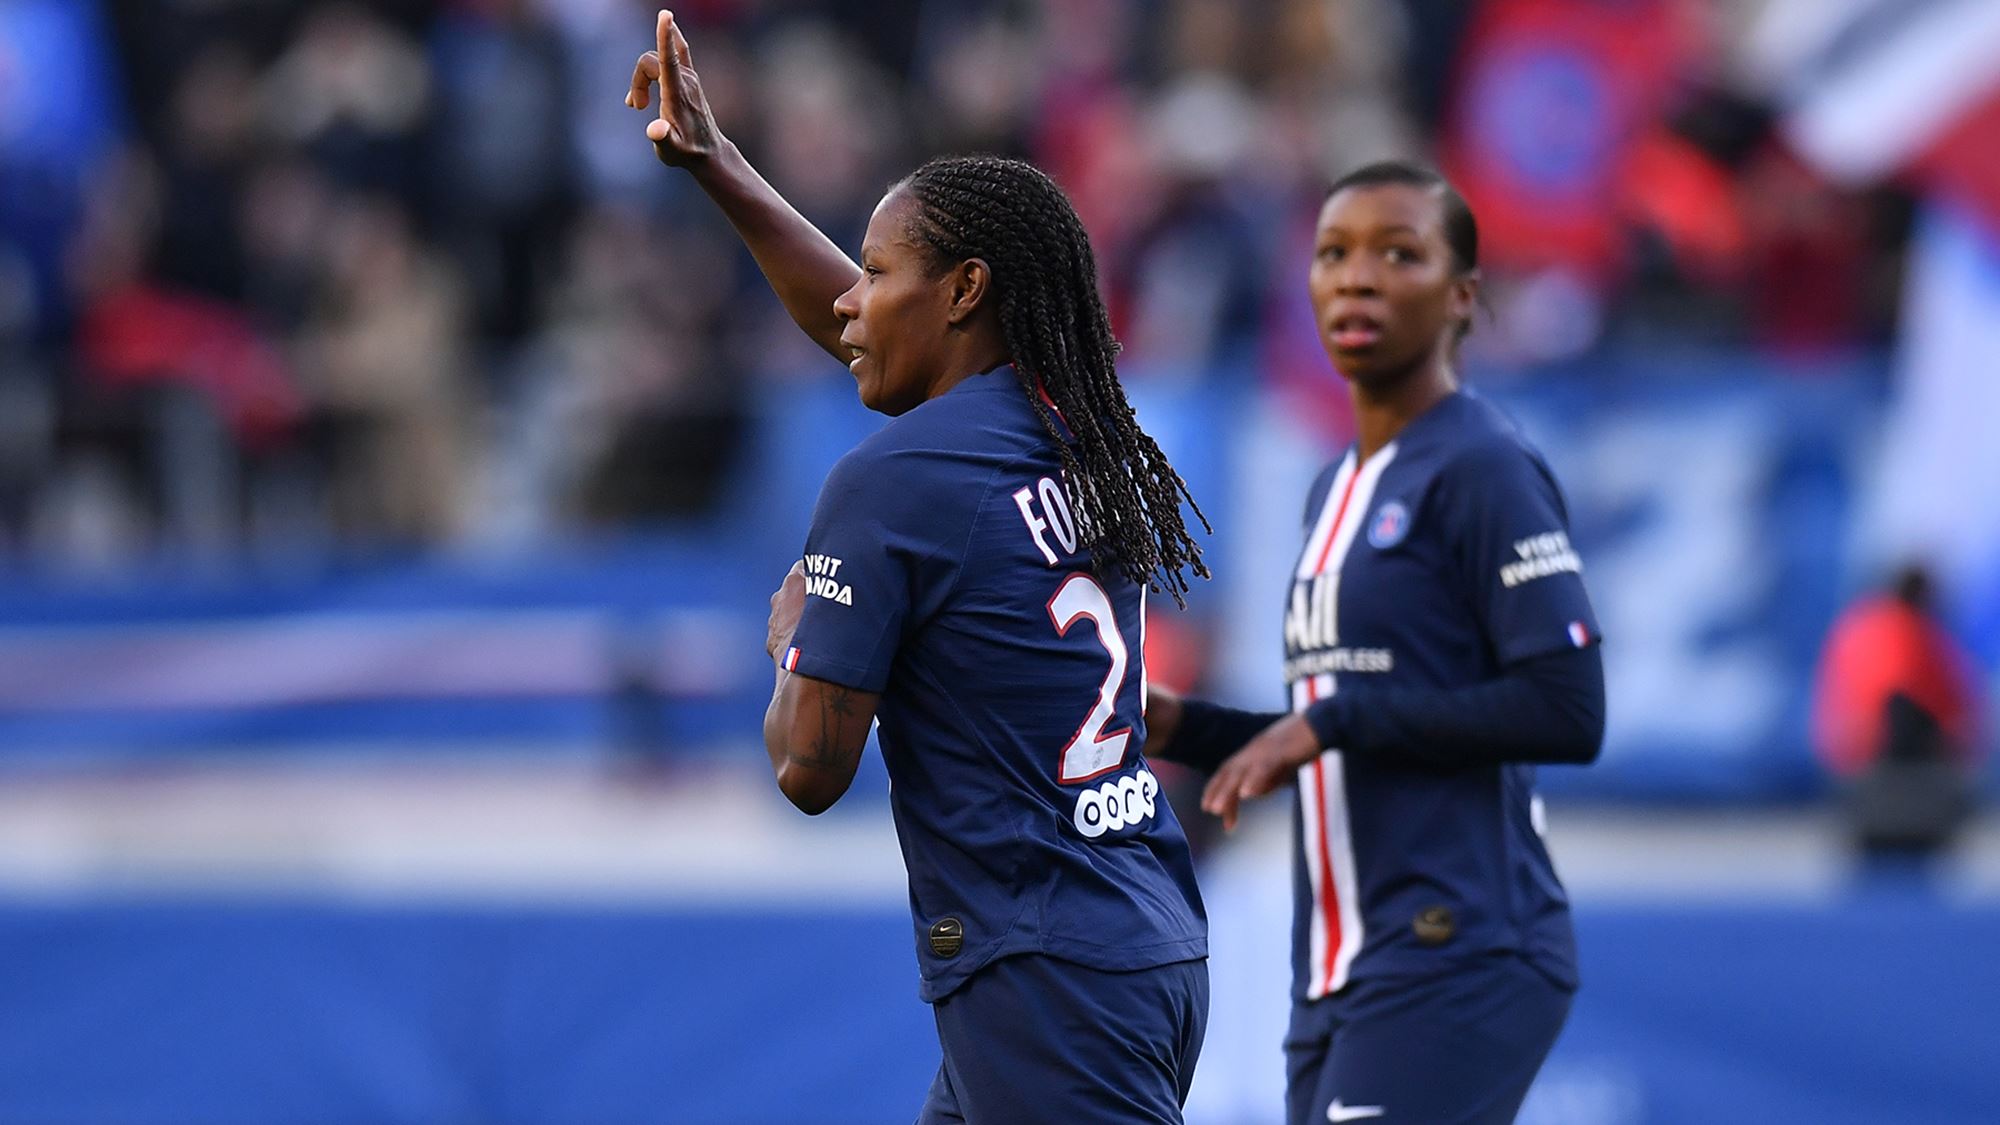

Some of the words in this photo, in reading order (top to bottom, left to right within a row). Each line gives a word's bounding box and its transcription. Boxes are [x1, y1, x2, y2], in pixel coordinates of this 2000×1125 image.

[1513, 531, 1569, 560] VISIT
[805, 554, 842, 577] VISIT
[805, 576, 852, 606] ANDA
[1046, 571, 1147, 784] 2
